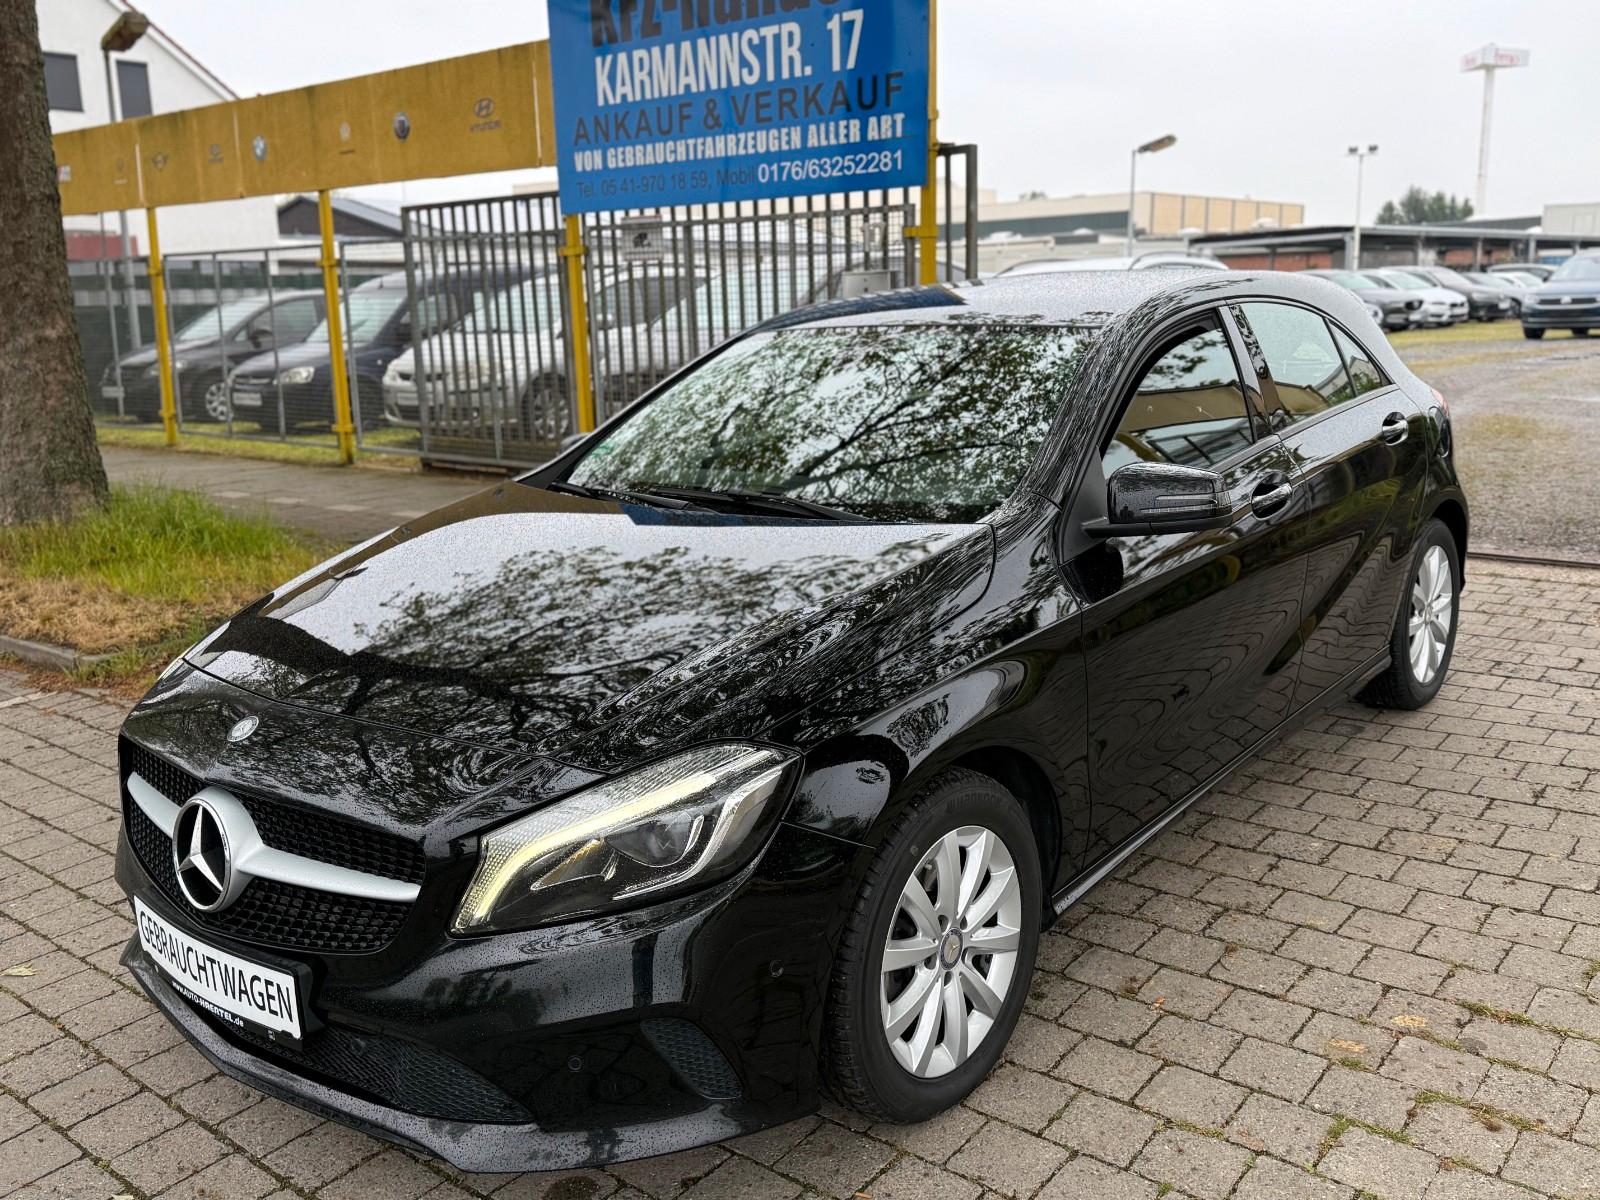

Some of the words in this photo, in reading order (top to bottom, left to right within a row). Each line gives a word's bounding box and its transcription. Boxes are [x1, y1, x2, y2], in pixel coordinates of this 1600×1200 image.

[595, 22, 812, 106] KARMANNSTR.
[826, 9, 864, 72] 17
[574, 103, 693, 146] ANKAUF
[703, 98, 722, 130] &
[730, 72, 904, 125] VERKAUF
[574, 147, 603, 172] VON
[607, 126, 801, 168] GEBRAUCHTFAHRZEUGEN
[807, 117, 861, 148] ALLER
[867, 114, 906, 139] ART
[757, 149, 903, 184] 0176/63252281
[140, 910, 294, 1023] GEBRAUCHTWAGEN
